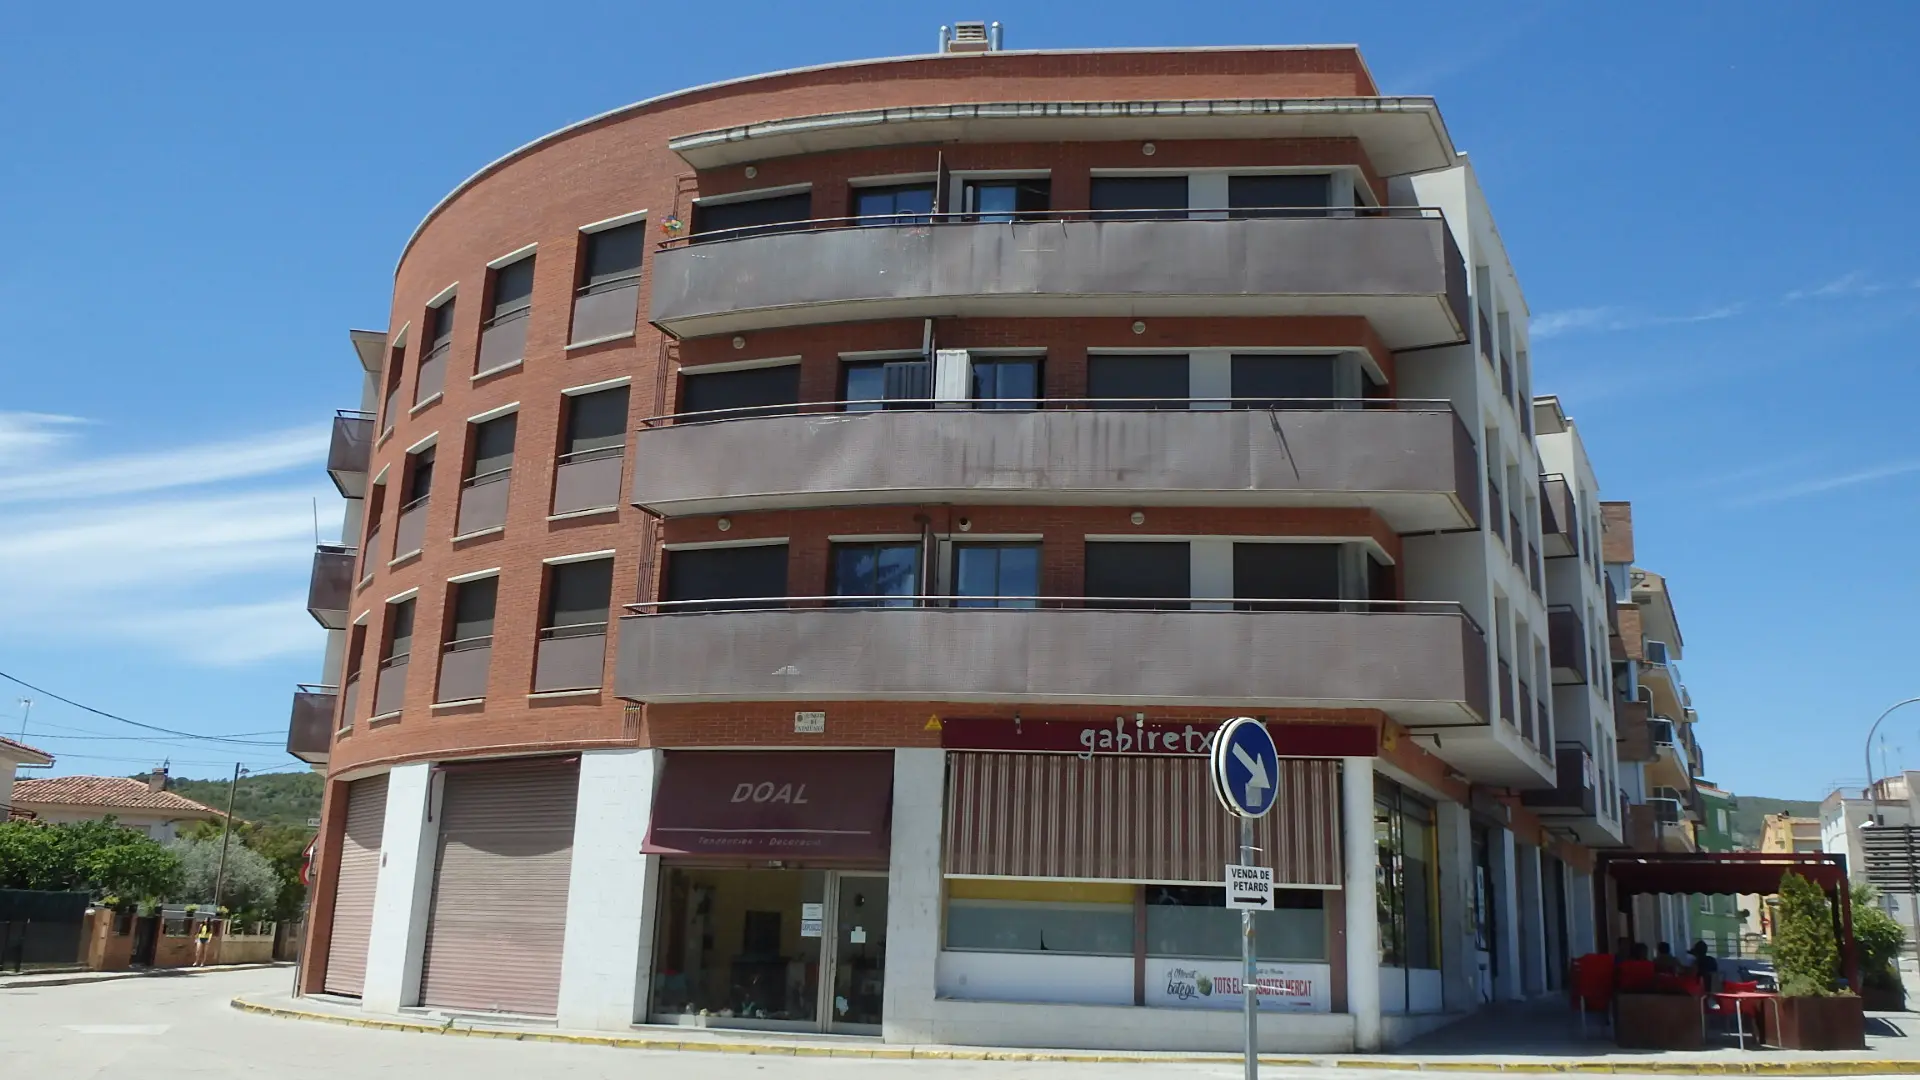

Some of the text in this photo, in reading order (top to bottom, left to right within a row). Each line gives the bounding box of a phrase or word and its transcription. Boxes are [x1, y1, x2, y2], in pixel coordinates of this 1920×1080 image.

[1078, 713, 1214, 760] gabiretx
[730, 781, 808, 804] DOAL
[1231, 868, 1270, 880] VENDA DE
[1233, 881, 1269, 892] PETARDS
[1213, 976, 1231, 994] TOTS
[1285, 979, 1312, 997] MERCAT
